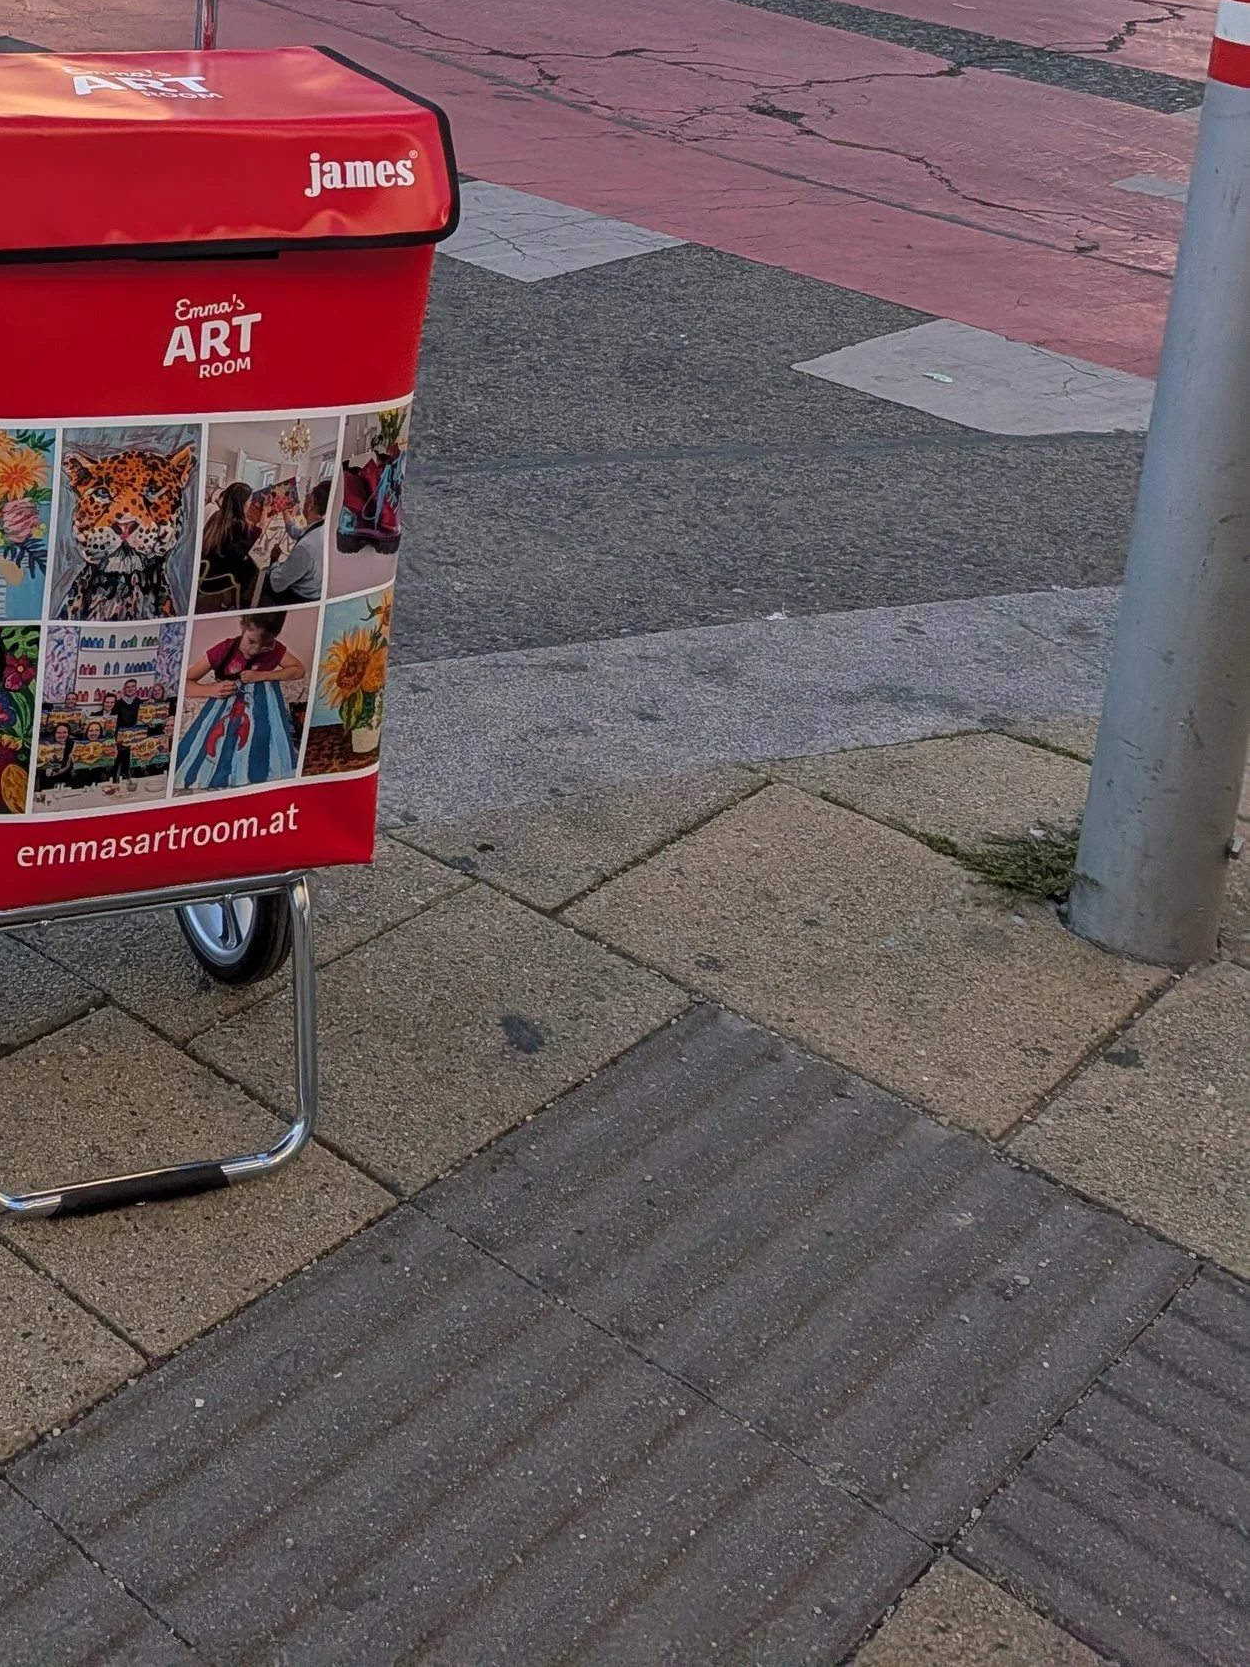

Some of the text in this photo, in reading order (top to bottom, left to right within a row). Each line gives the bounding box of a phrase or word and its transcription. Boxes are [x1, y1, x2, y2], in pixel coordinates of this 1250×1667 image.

[72, 75, 210, 96] ART
[174, 293, 246, 321] Emma's
[162, 312, 263, 367] ART
[198, 356, 252, 379] ROOM
[16, 802, 300, 867] emmasartroom.at
